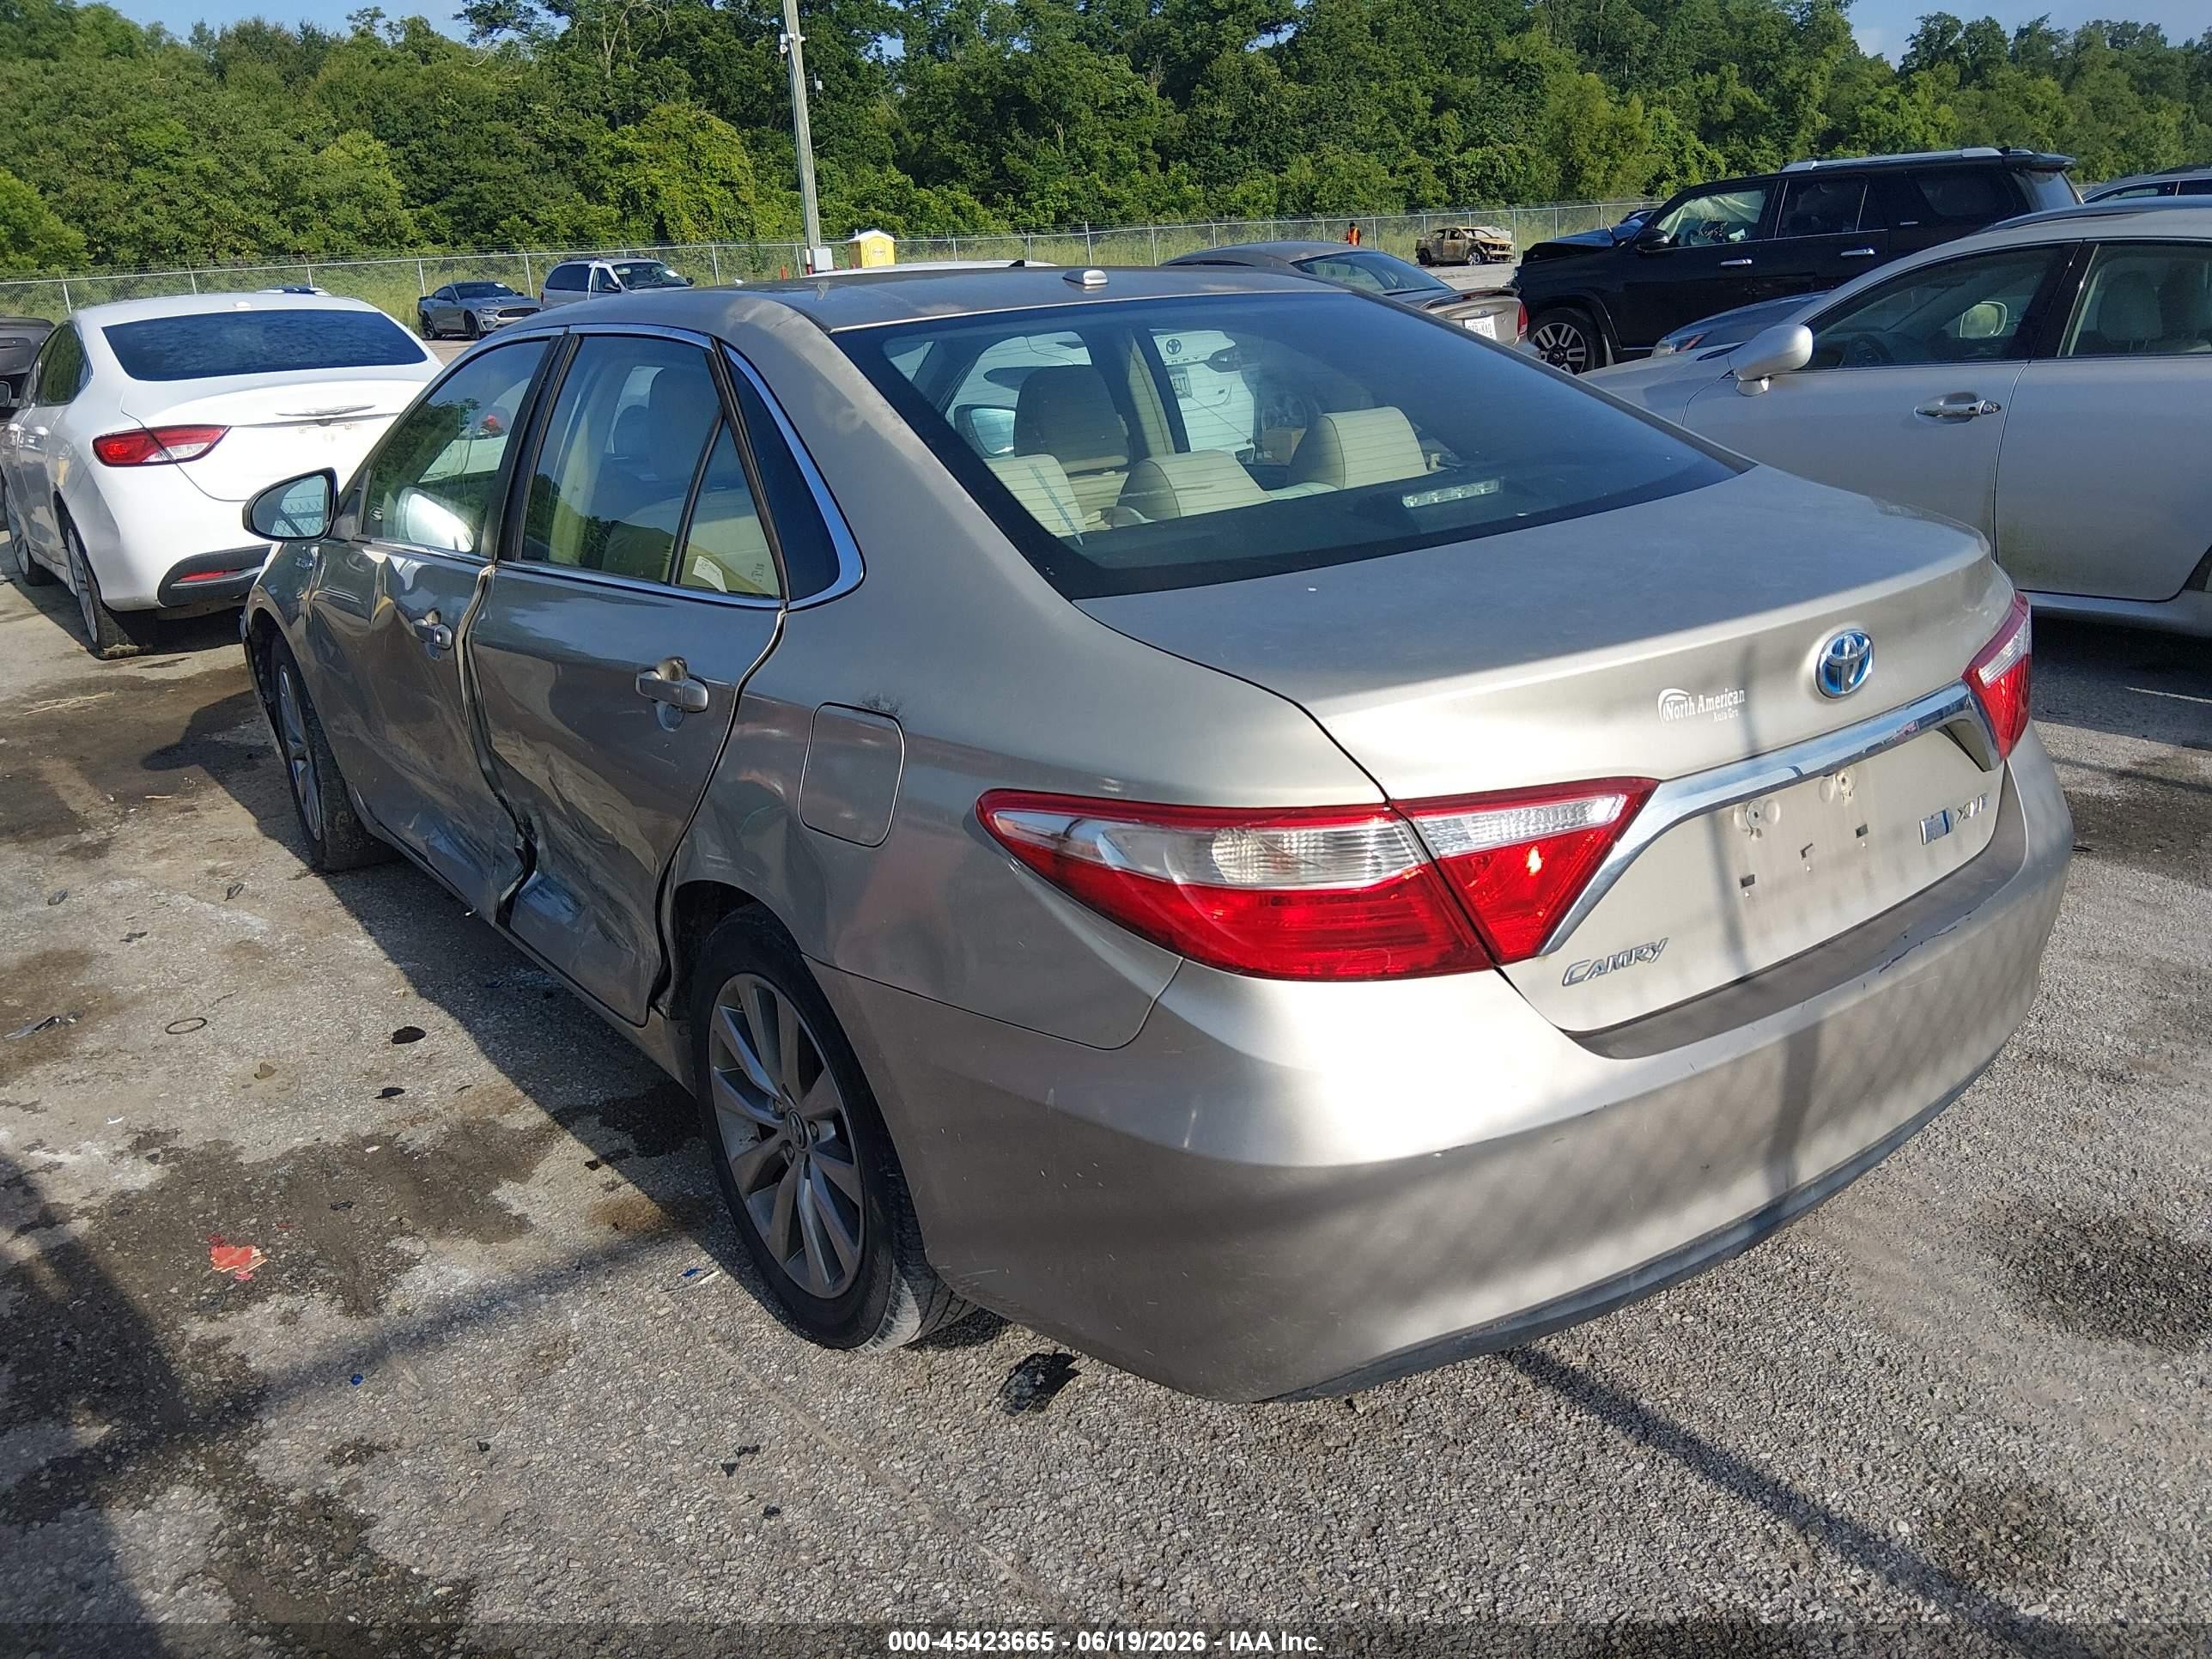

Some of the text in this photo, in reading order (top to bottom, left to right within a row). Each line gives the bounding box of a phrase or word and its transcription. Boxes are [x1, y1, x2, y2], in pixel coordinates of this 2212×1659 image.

[1662, 687, 1746, 721] North American
[1562, 938, 1669, 987] CAMRY
